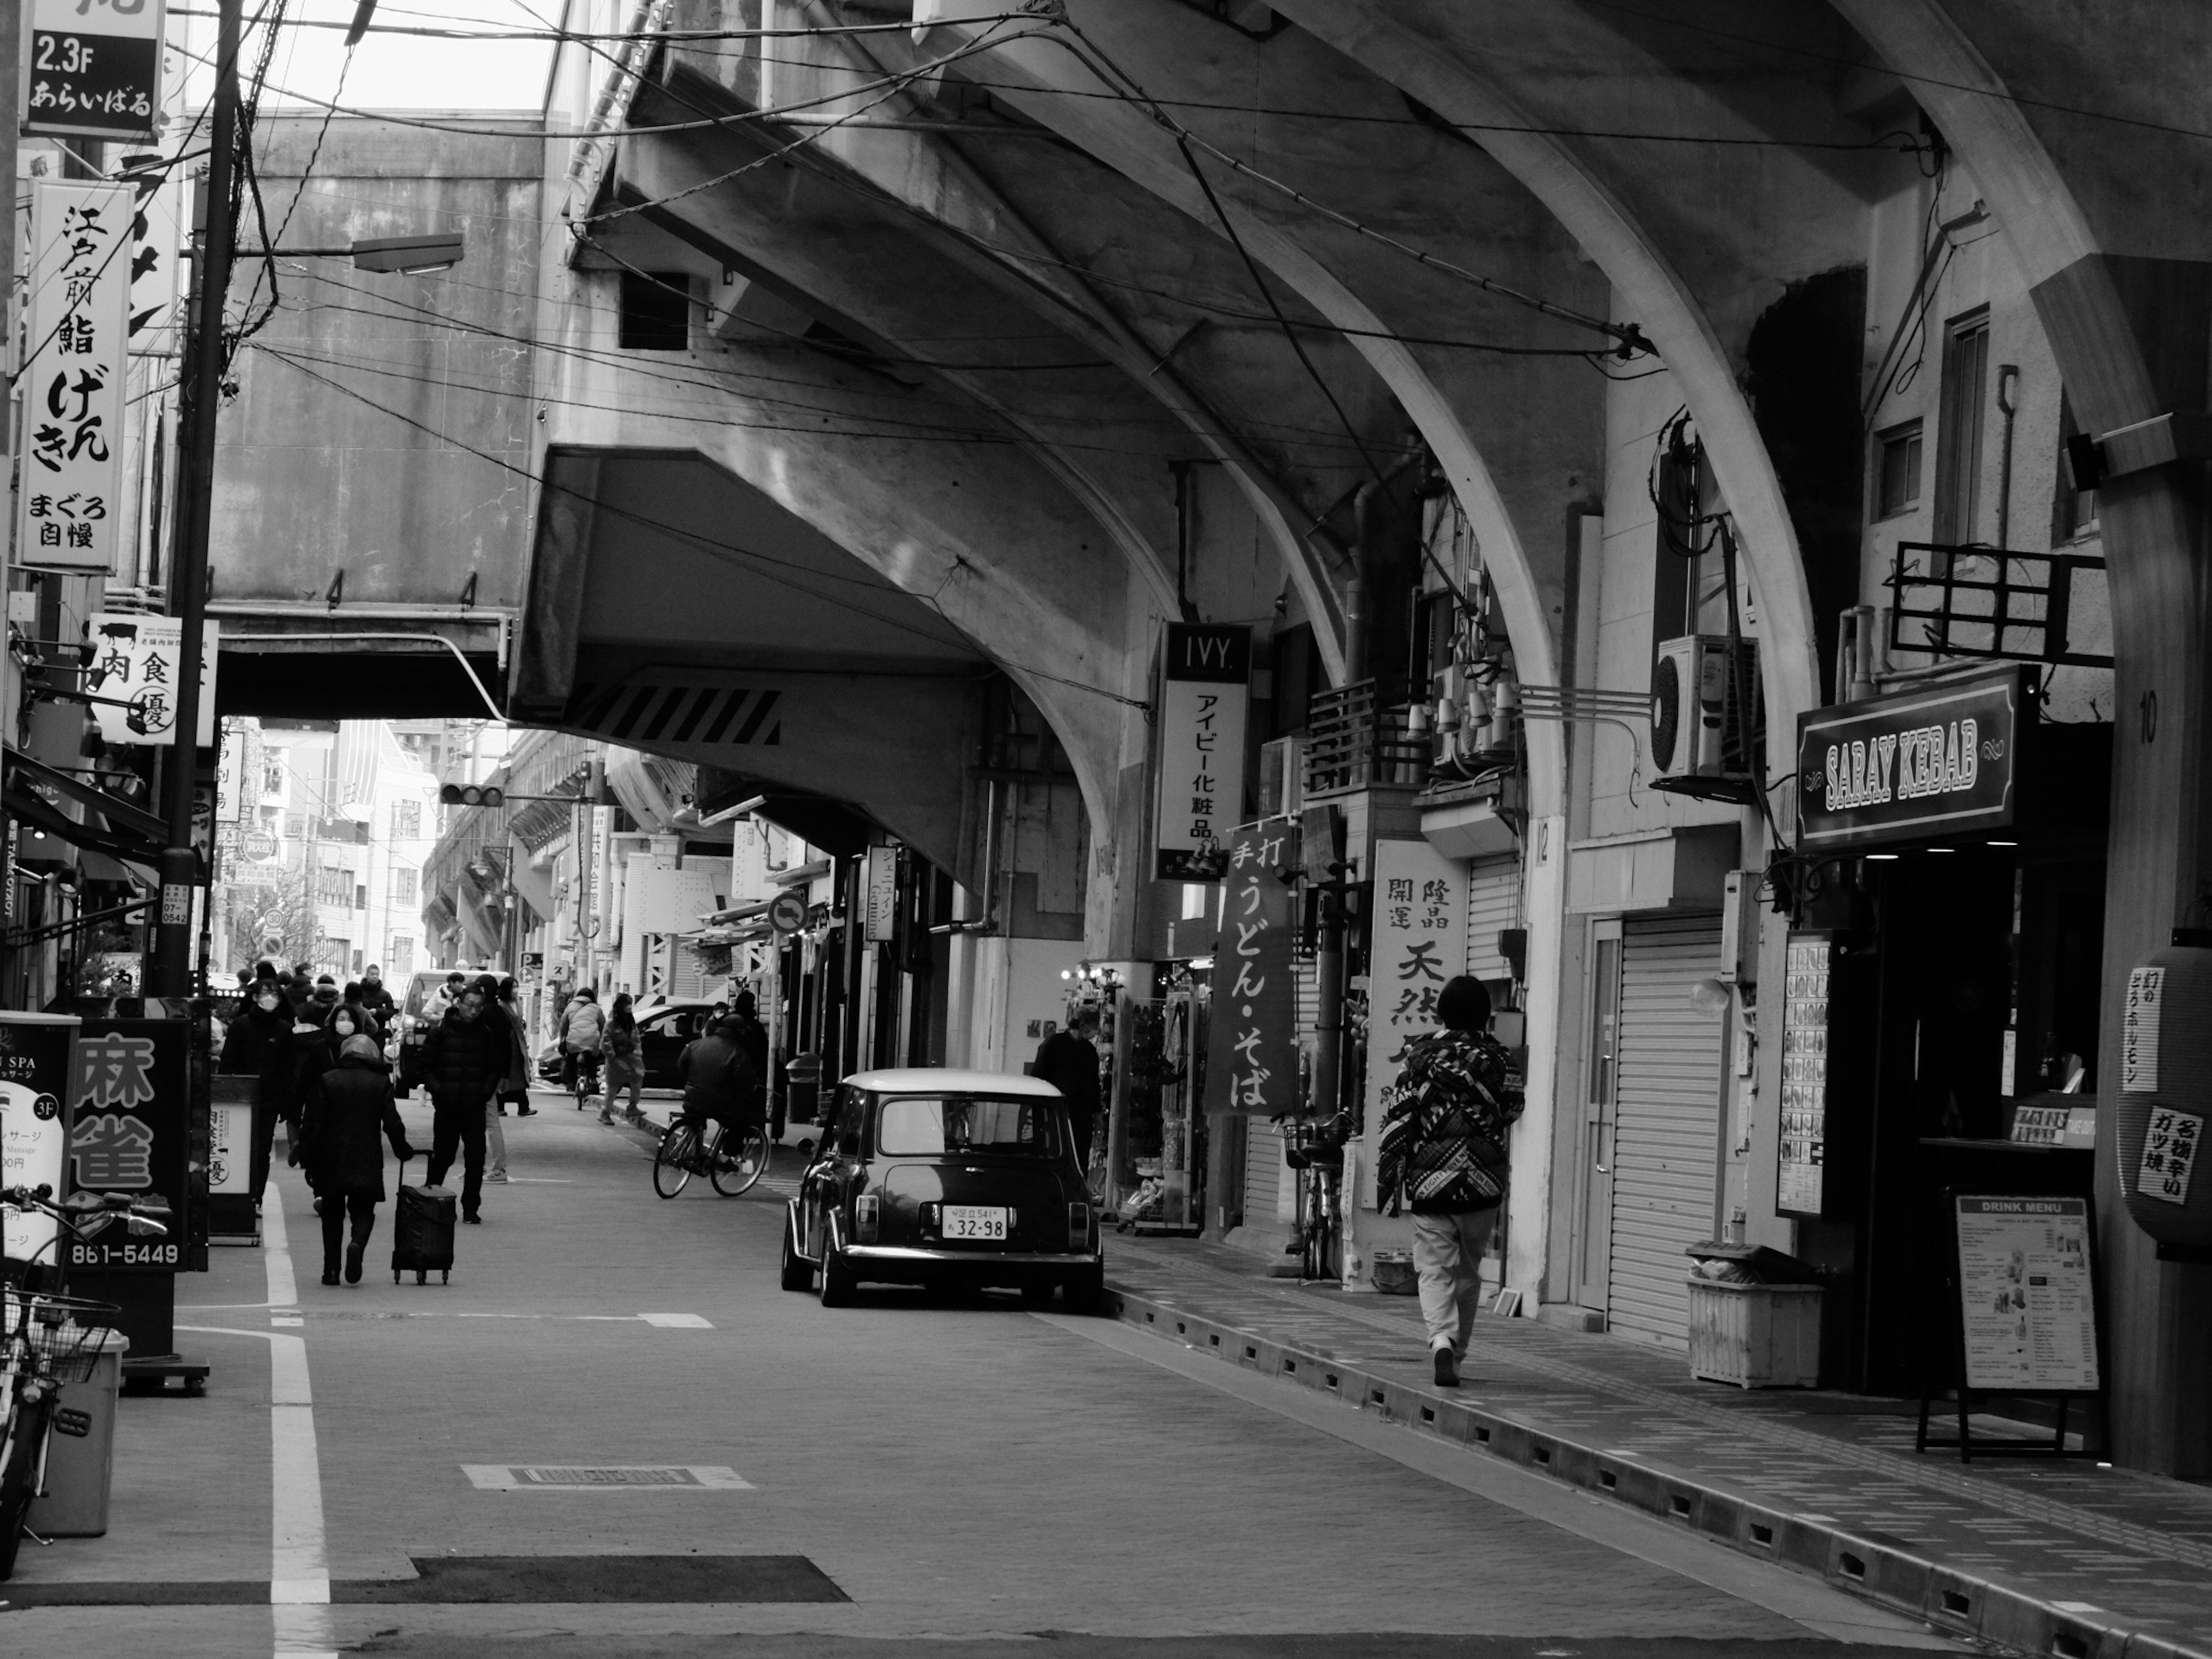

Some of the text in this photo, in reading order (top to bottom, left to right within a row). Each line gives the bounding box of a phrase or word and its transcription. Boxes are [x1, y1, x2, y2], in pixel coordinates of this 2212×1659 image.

[36, 35, 94, 74] 2.3F
[29, 80, 150, 116] あらいばる
[59, 205, 108, 356] 江戸前鮨
[29, 493, 107, 519] まぐろ
[40, 521, 93, 548] 自慢
[1186, 636, 1230, 668] IVY
[1190, 695, 1218, 838] アイビー化粧品
[1825, 718, 1978, 812] SARAY KEBAB
[1232, 837, 1285, 869] 手打
[881, 851, 893, 919] ジェニュイン
[164, 914, 187, 923] 0542
[268, 914, 281, 924] 30
[869, 885, 881, 938] Genuine
[1230, 876, 1271, 1107] うどん・そば
[9, 1056, 36, 1069] SPA
[37, 1101, 54, 1115] 3F
[71, 1032, 155, 1188] 麻雀
[7, 1146, 36, 1155] Massage
[1982, 1202, 2062, 1213] DRINK MENU
[958, 1220, 1002, 1236] 32-98
[72, 1244, 179, 1264] 861-5449
